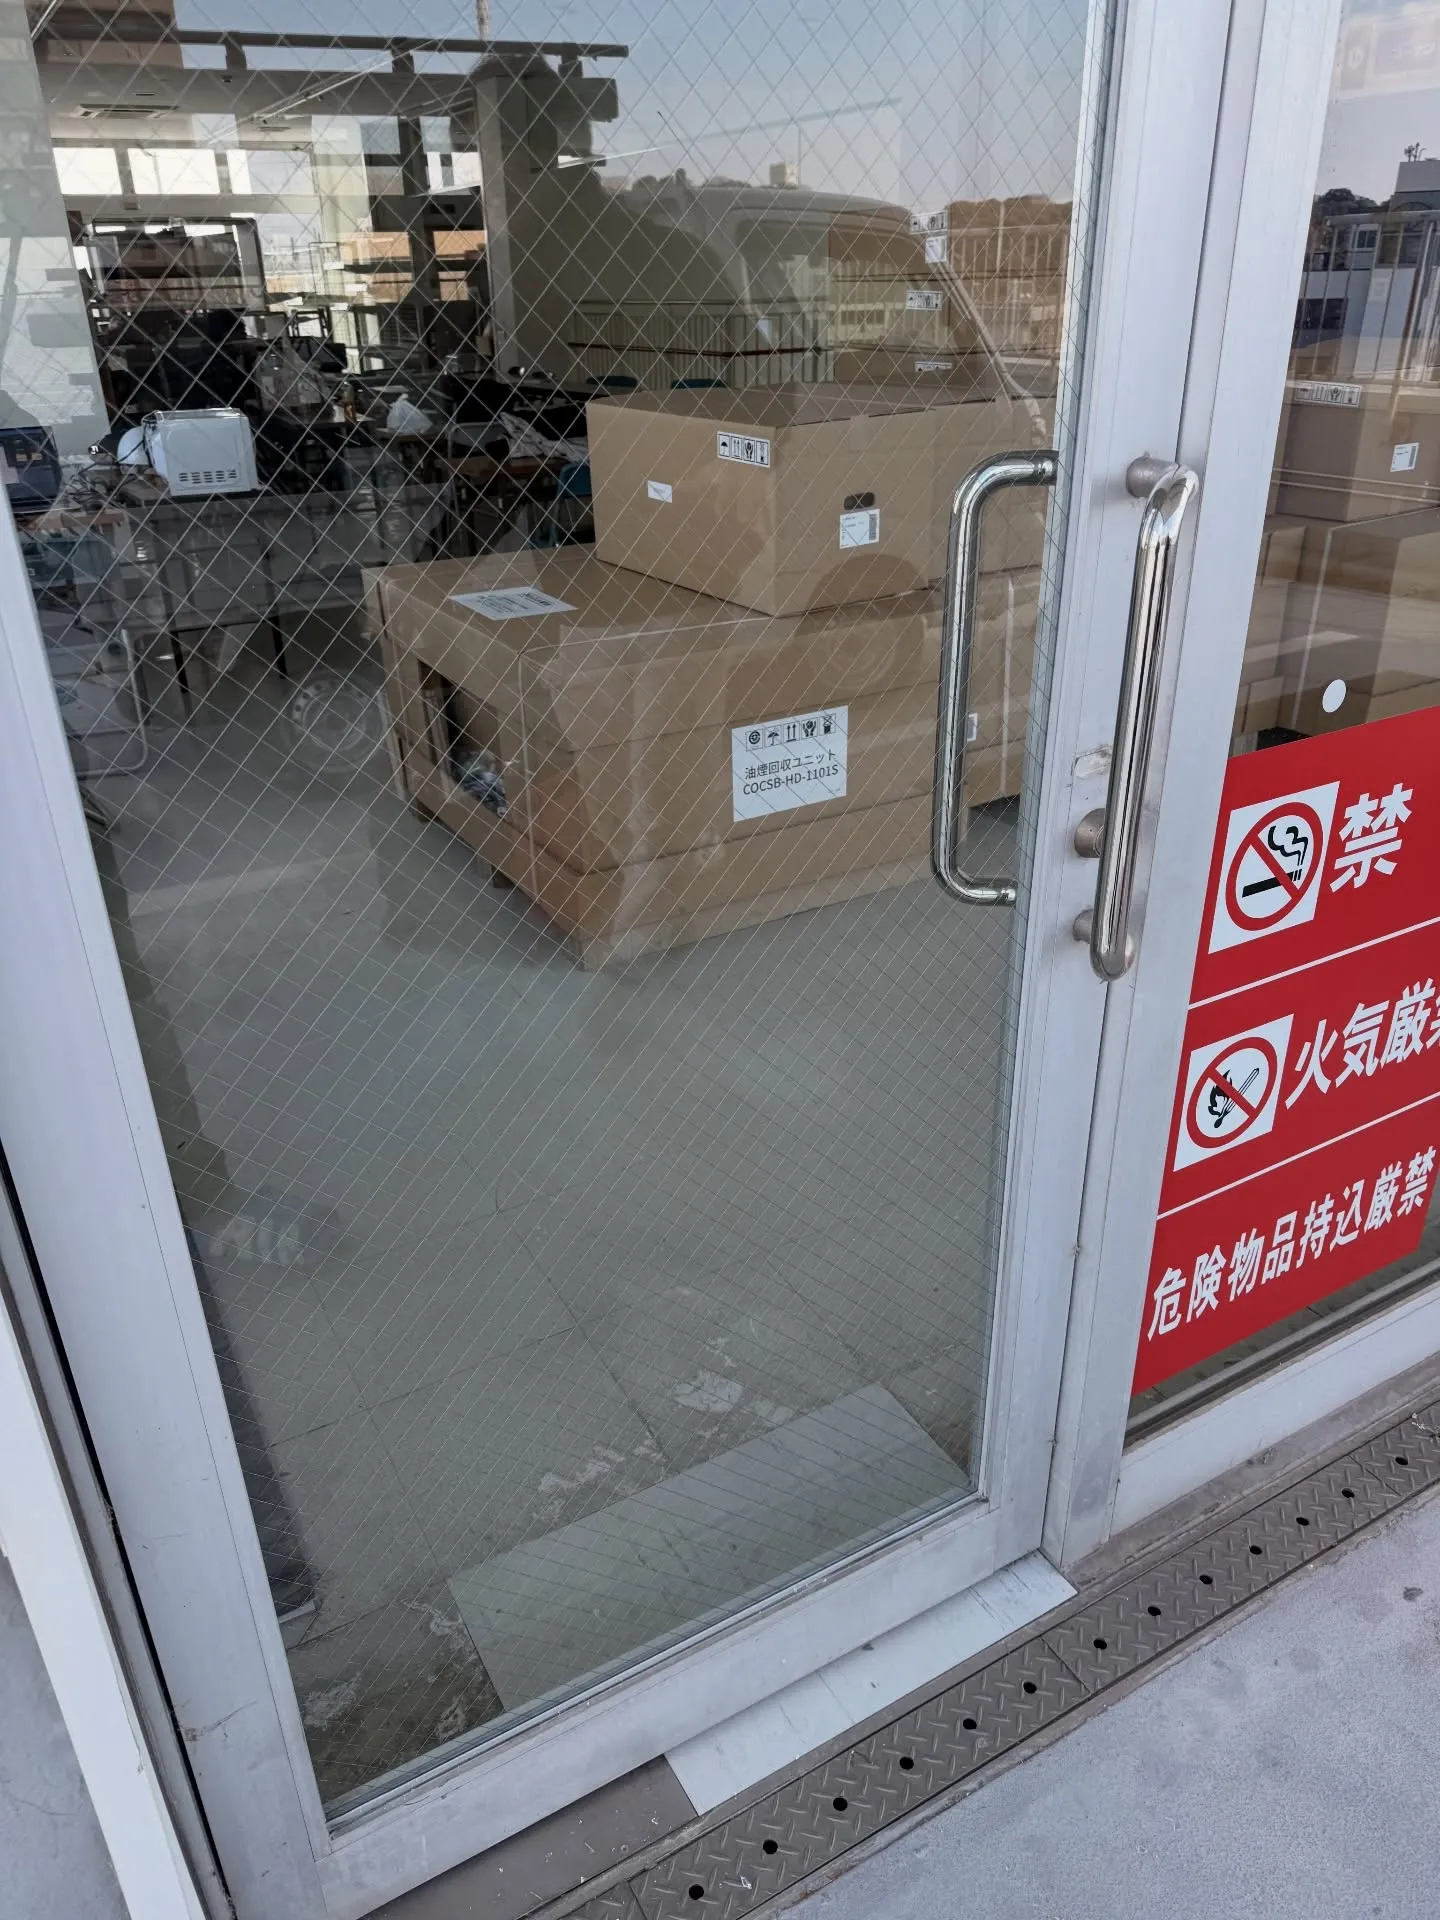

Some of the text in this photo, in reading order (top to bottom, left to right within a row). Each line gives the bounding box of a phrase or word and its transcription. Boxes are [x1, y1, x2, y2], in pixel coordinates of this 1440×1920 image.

[744, 749, 836, 780] 油煙回収ユニット
[1329, 782, 1414, 893] 禁
[1147, 1145, 1437, 1342] 危険物品持込厳禁
